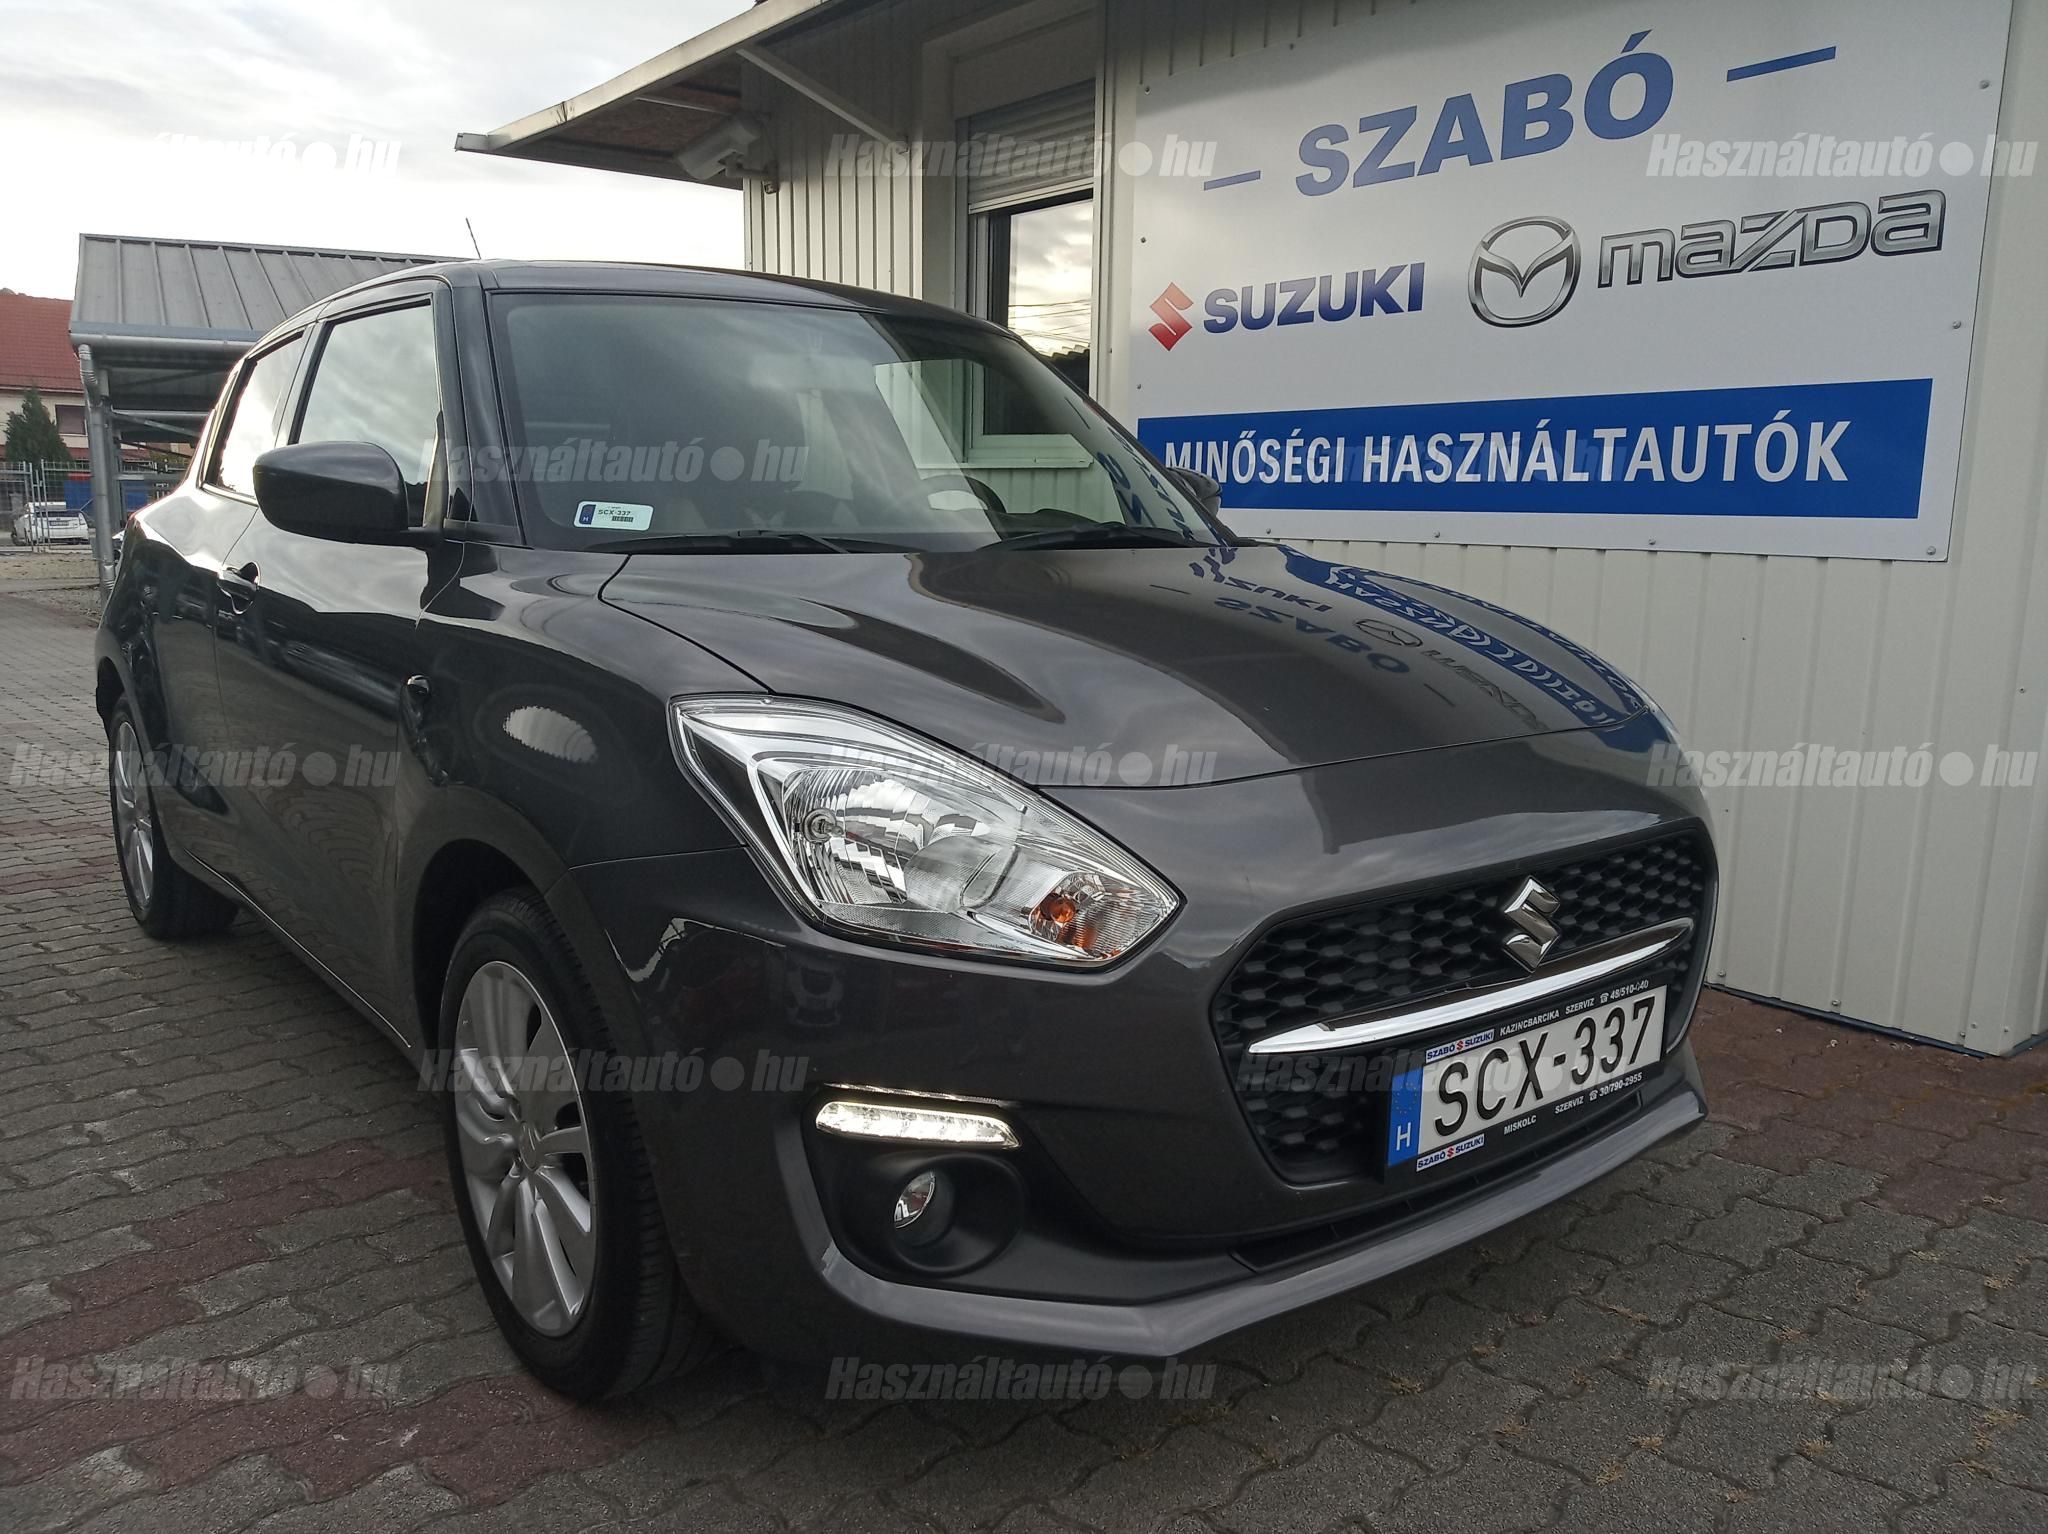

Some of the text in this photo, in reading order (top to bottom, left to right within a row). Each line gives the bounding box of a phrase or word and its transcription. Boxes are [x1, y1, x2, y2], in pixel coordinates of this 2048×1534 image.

[1294, 30, 1675, 197] SZABÓ
[1203, 262, 1425, 334] SUZUKI
[1164, 408, 1852, 485] MINŐSÉGI HASZNÁLTAUTÓK
[1426, 1042, 1456, 1060] SZABÓ
[1464, 1031, 1494, 1048] SUZUKI
[1500, 1010, 1560, 1037] KAZINCBARCIKA
[1565, 998, 1595, 1015] SZERVIZ
[1434, 994, 1656, 1137] SCX-337
[1396, 1121, 1412, 1151] H
[1455, 1136, 1484, 1153] SUZUKI
[1503, 1115, 1537, 1135] MISKOLC
[1554, 1096, 1585, 1114] SZERVIZ
[1599, 1072, 1643, 1097] 30/790-2955
